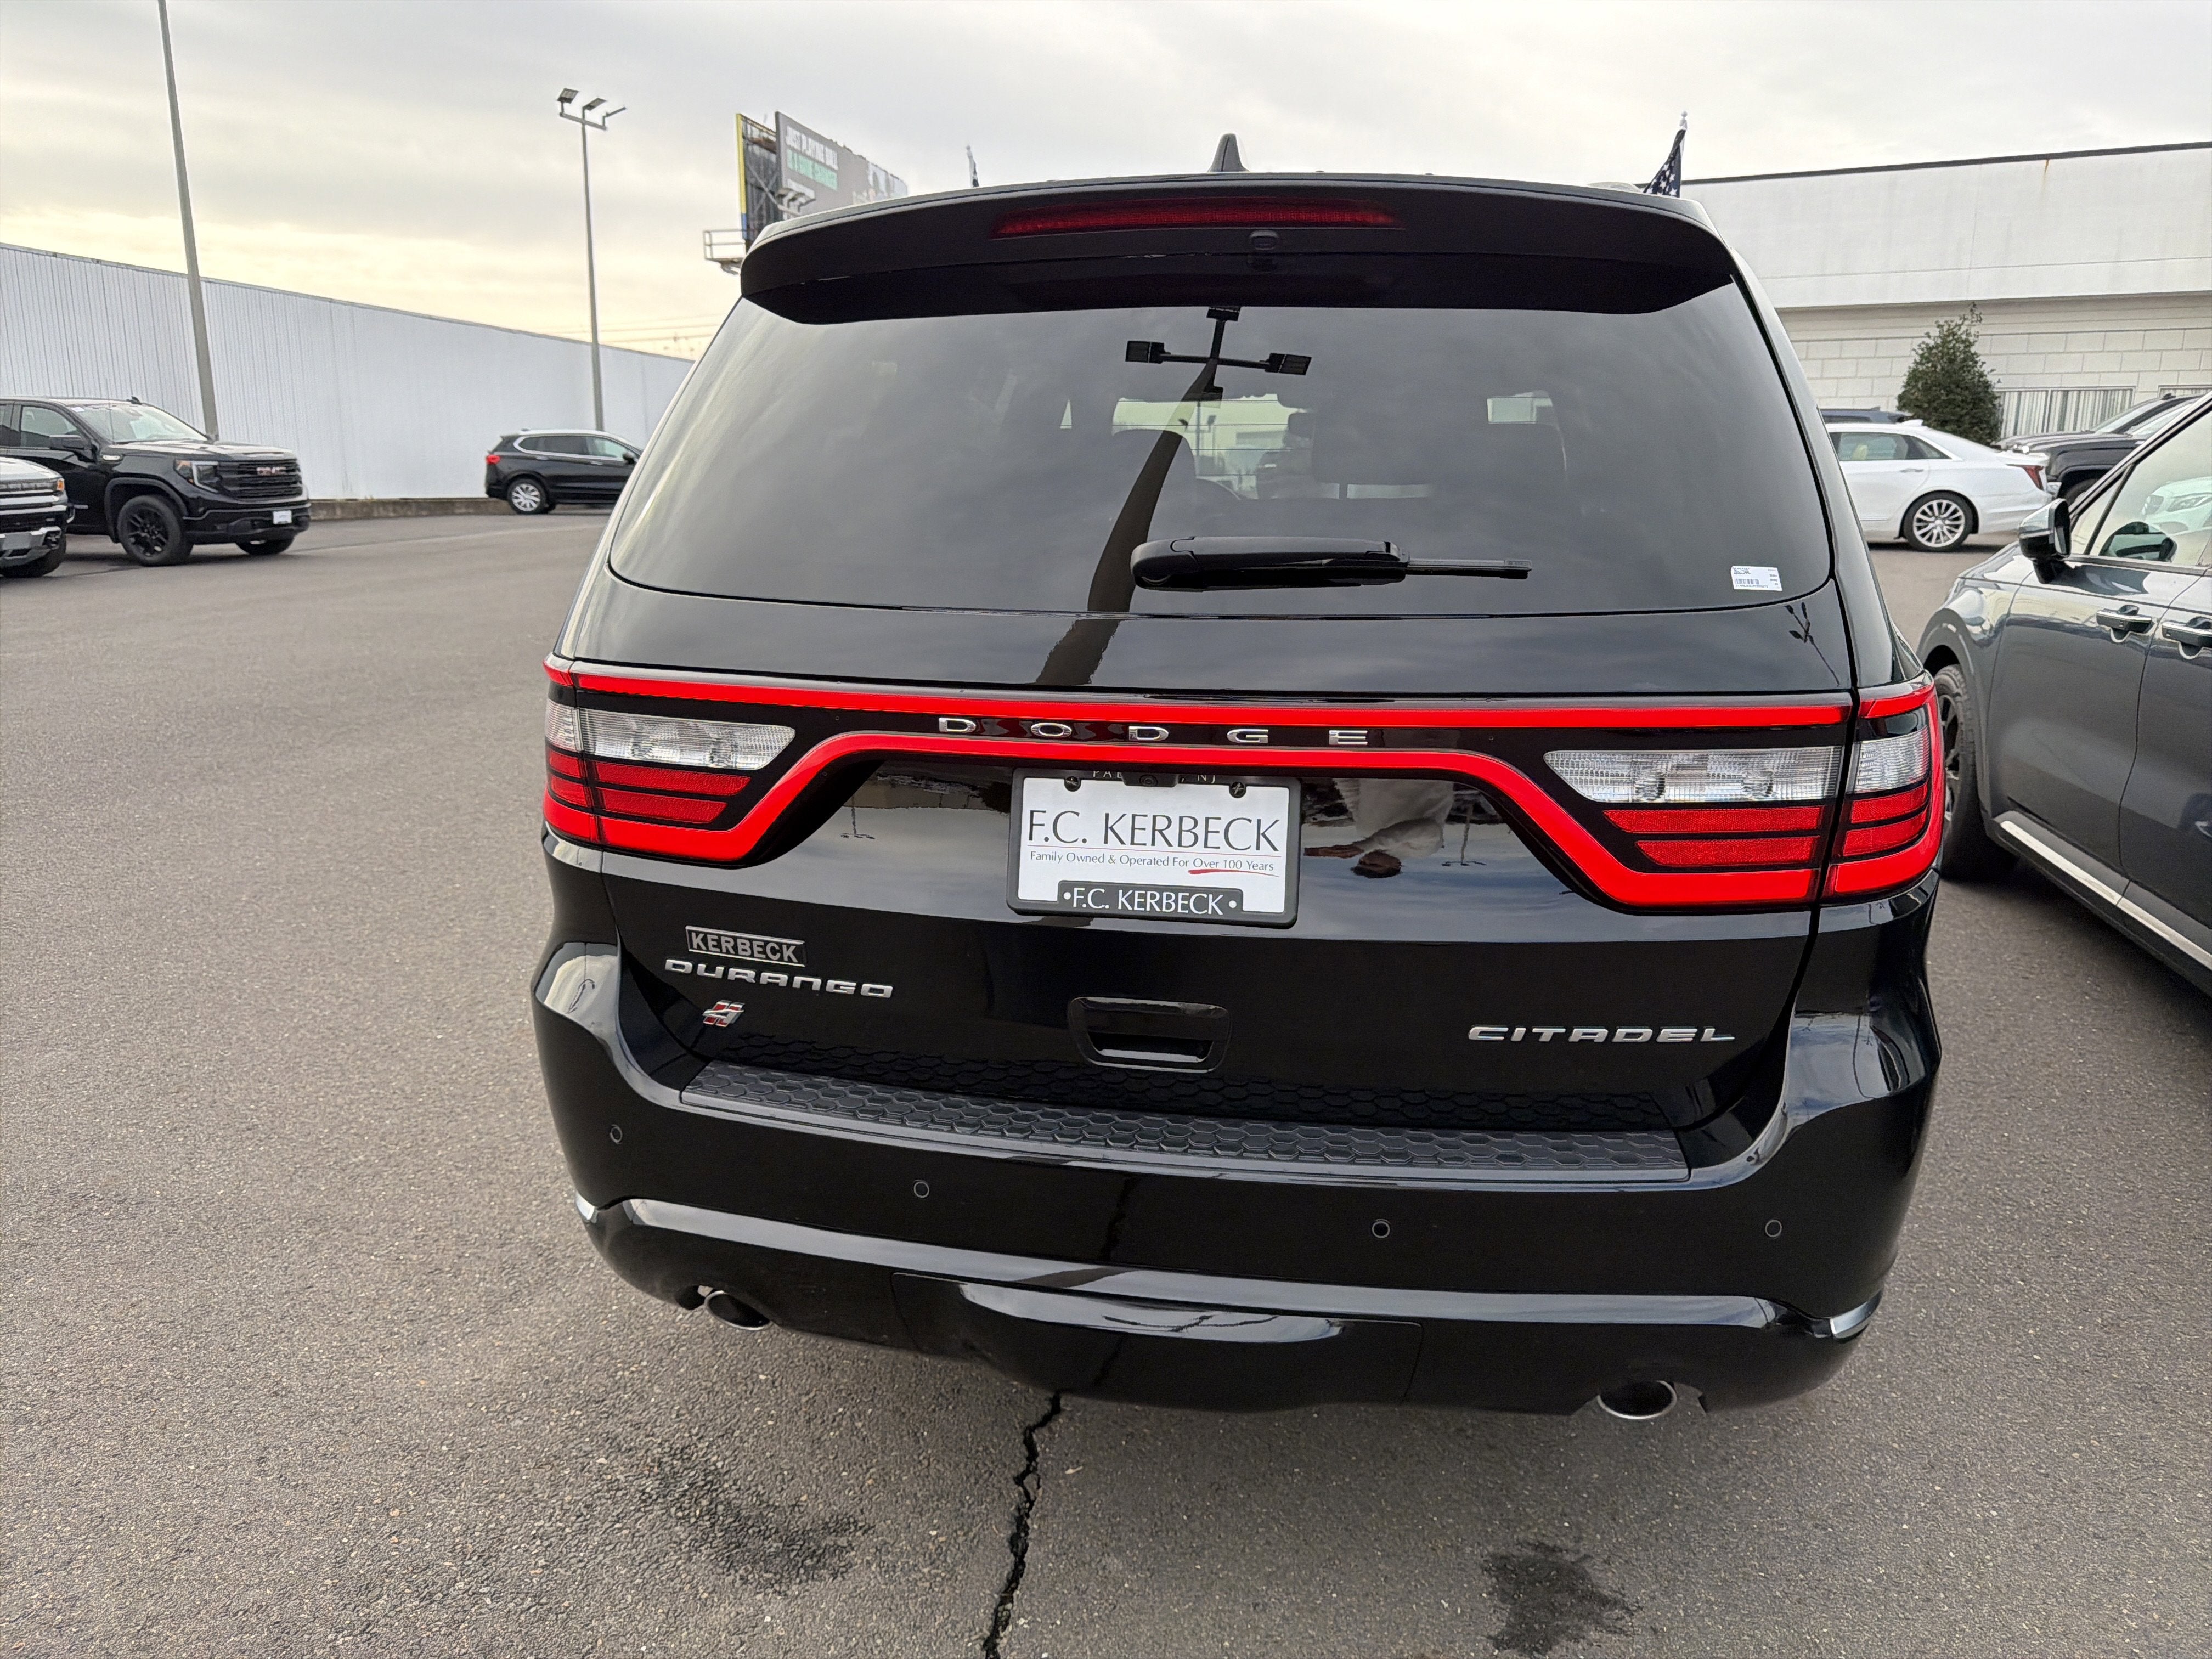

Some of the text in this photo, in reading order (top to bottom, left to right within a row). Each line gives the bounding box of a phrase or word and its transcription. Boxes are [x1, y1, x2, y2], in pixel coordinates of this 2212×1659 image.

[939, 717, 1368, 746] DODGE
[1028, 810, 1280, 852] F.C. KERBECK
[1030, 851, 1274, 871] Family Owned & Operated For Over 100 Years
[1073, 887, 1224, 916] F.C. KERBECK
[691, 932, 799, 962] KERBECK
[665, 958, 893, 998] DURANGO
[1468, 1026, 1735, 1042] CITADEL
